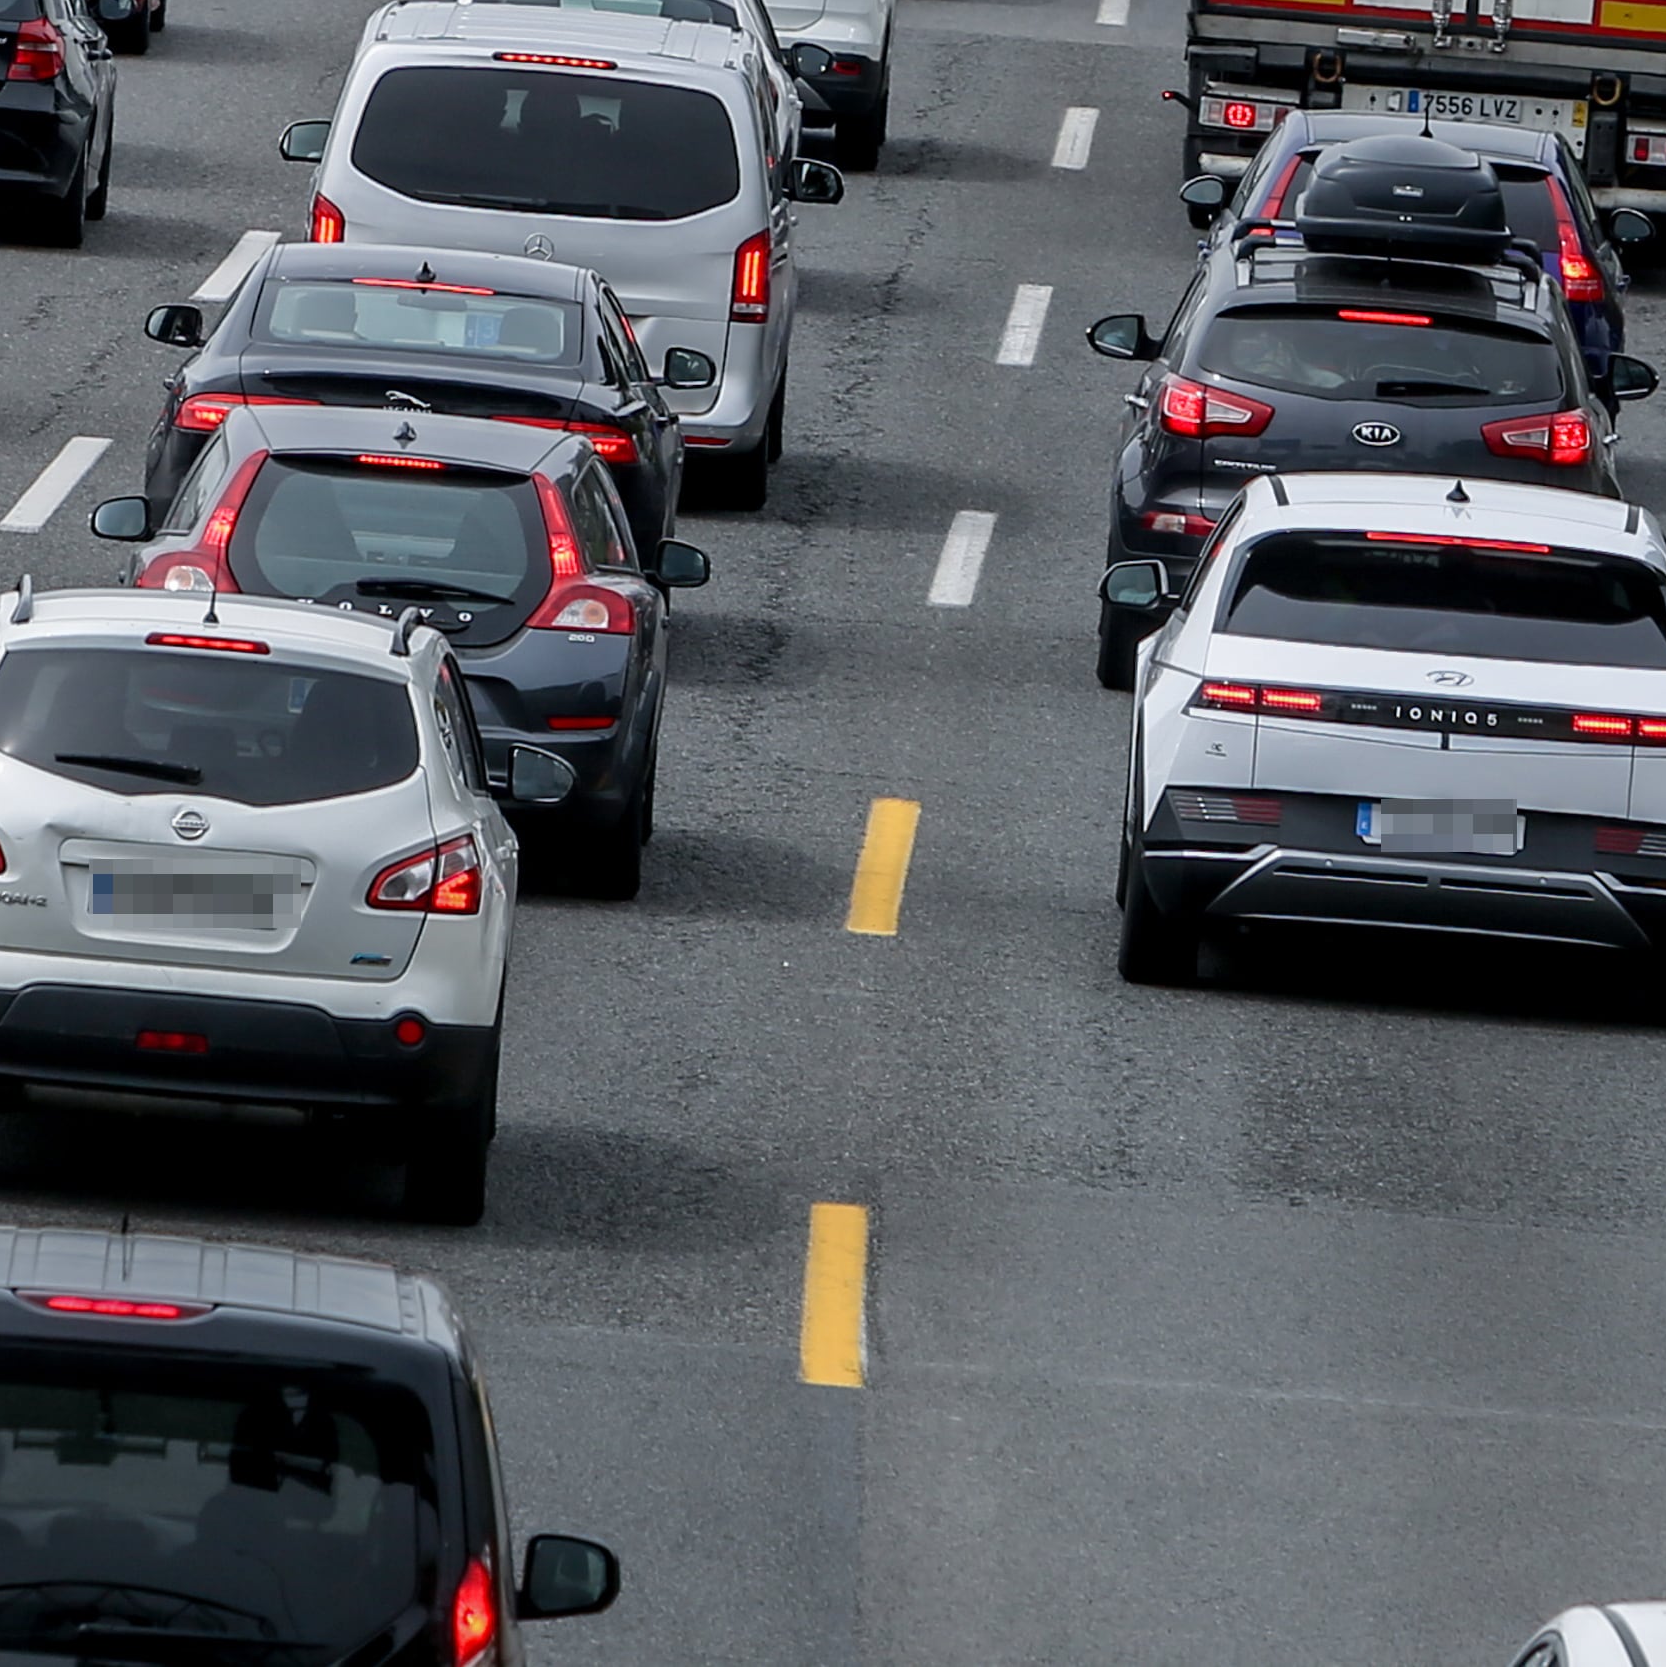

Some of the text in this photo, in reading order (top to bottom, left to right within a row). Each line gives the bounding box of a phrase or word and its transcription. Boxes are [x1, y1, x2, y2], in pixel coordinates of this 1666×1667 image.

[1423, 94, 1518, 119] 7556 LVZ
[1360, 426, 1393, 441] KIA
[1394, 705, 1498, 727] IONIQ 5
